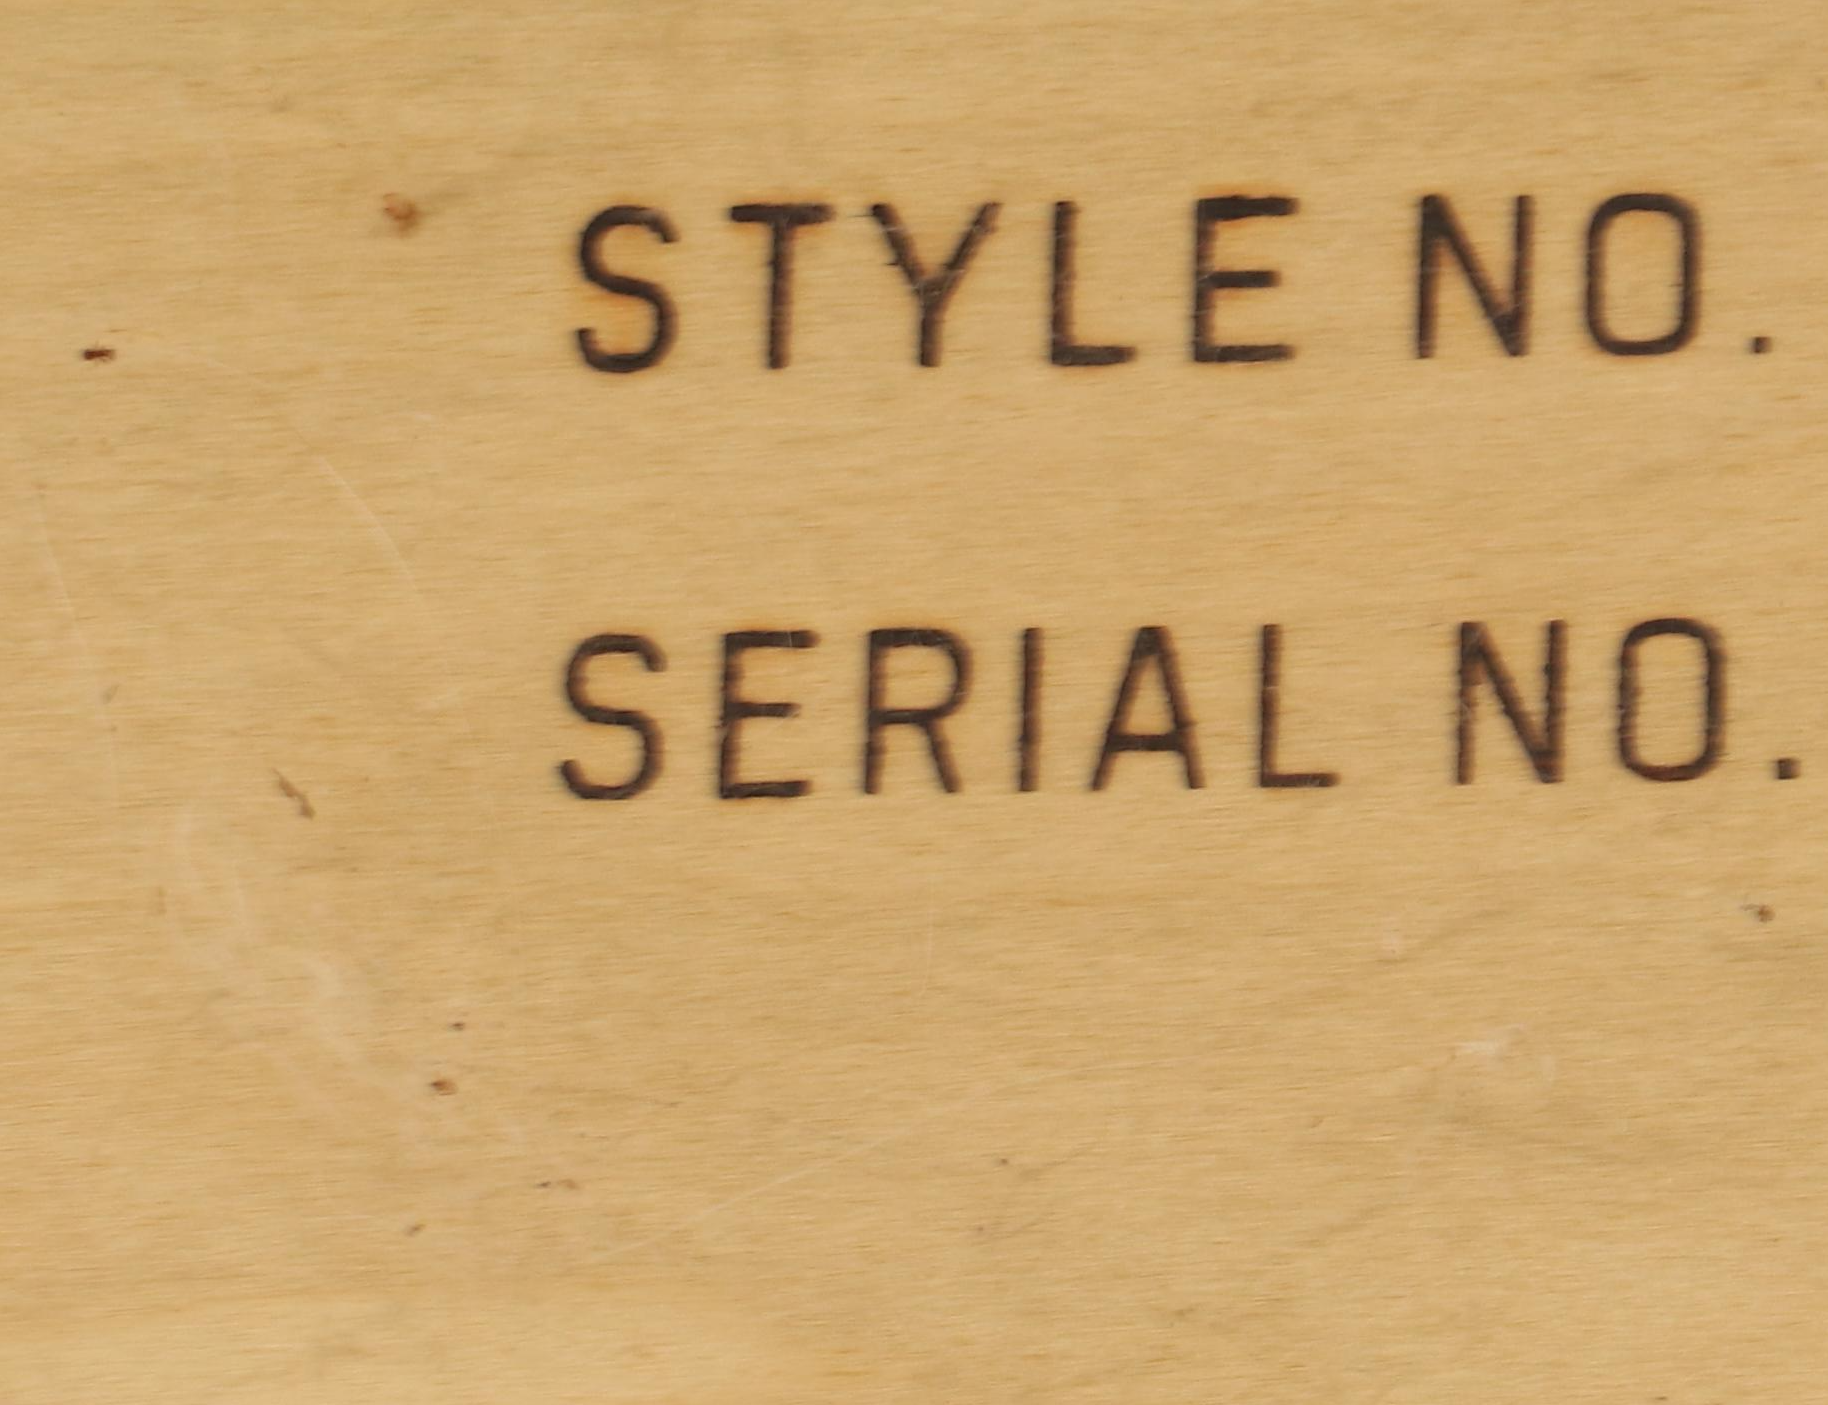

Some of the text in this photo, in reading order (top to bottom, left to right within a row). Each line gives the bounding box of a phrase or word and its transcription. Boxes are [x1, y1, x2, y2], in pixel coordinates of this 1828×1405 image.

[574, 194, 1298, 374] STYLE
[557, 625, 1339, 801] SERIAL
[1453, 617, 1798, 785] NO.
